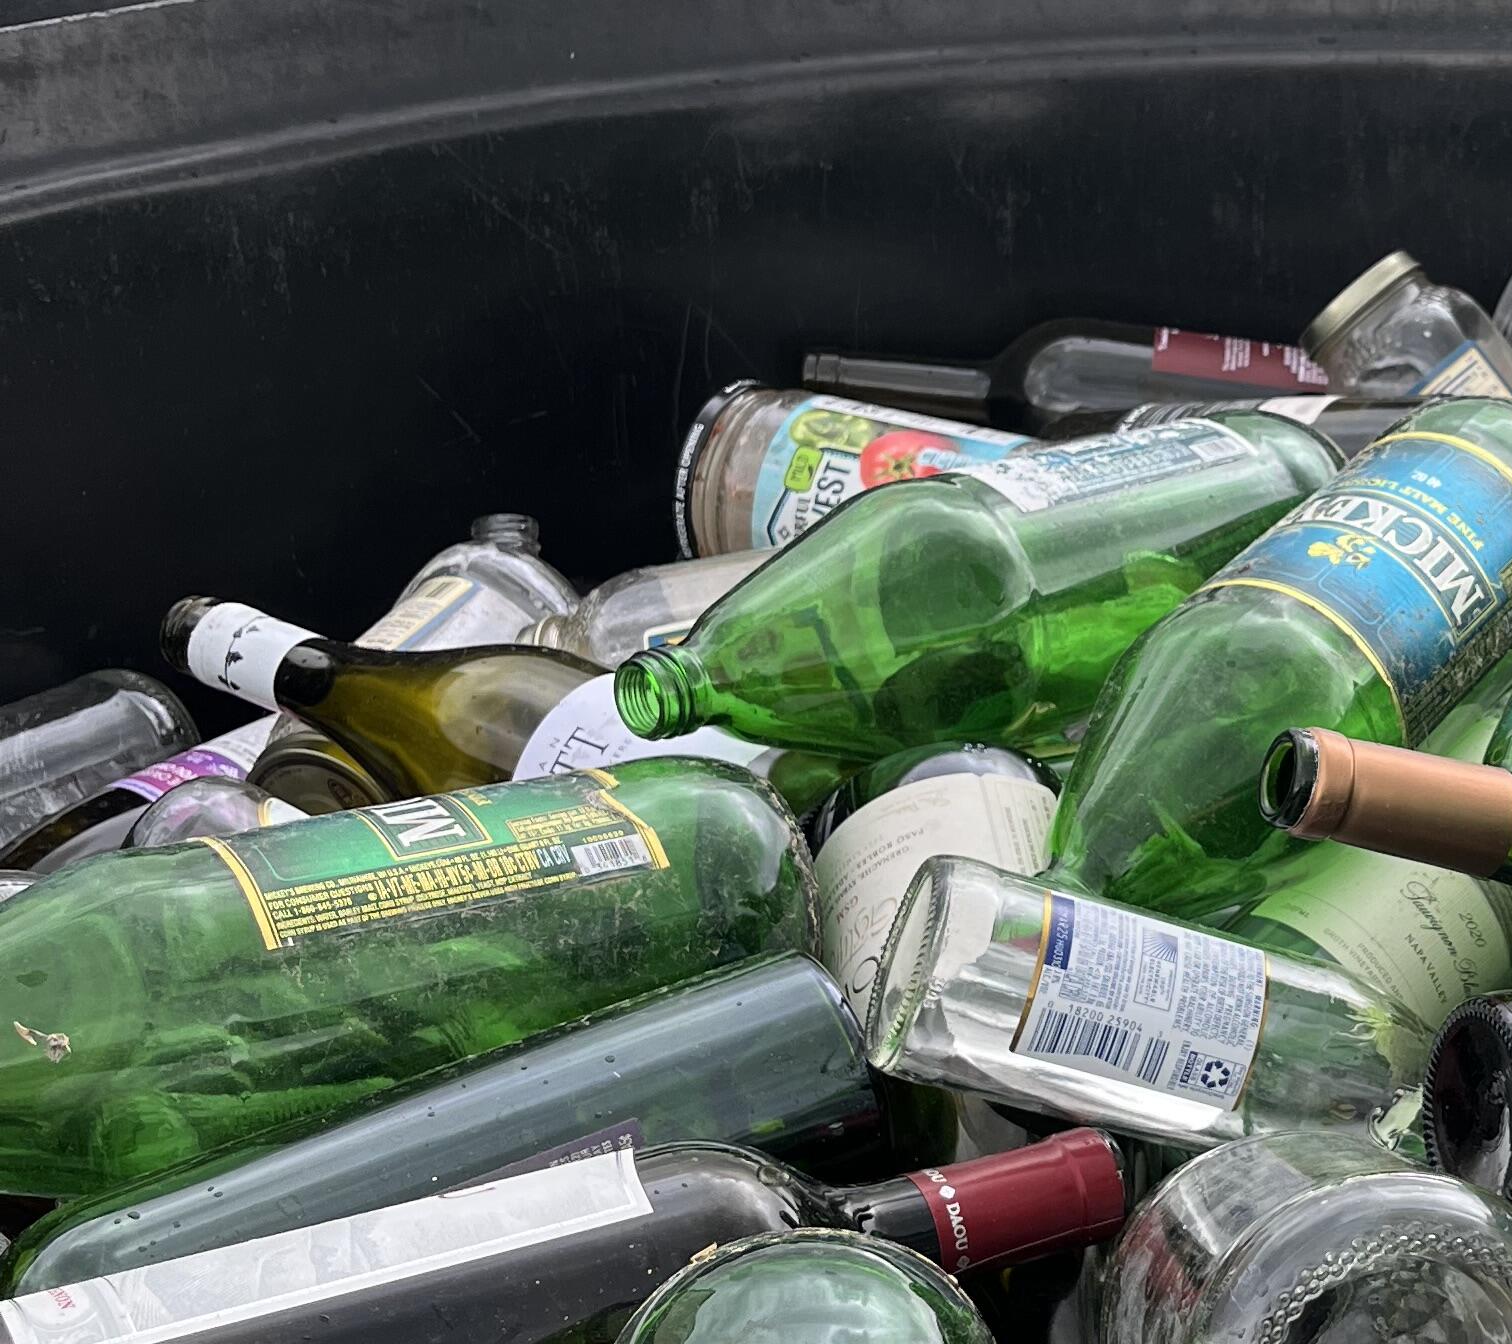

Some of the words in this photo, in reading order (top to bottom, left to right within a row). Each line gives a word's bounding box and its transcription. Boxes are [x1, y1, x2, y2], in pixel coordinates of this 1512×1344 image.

[1399, 484, 1447, 514] MALT
[1445, 511, 1484, 551] FINE
[896, 827, 924, 842] PASO
[268, 899, 283, 910] FOR
[283, 890, 329, 907] CONSUMER
[329, 882, 374, 898] QUESTIONS
[271, 906, 293, 919] CALL
[1398, 875, 1460, 958] Sauvignon
[1456, 908, 1489, 950] 2020
[1404, 933, 1428, 965] NAPA
[1423, 961, 1448, 1003] VALLEY
[1068, 1004, 1103, 1021] 18200
[1107, 1014, 1142, 1032] 25904
[945, 1201, 968, 1251] DAOU
